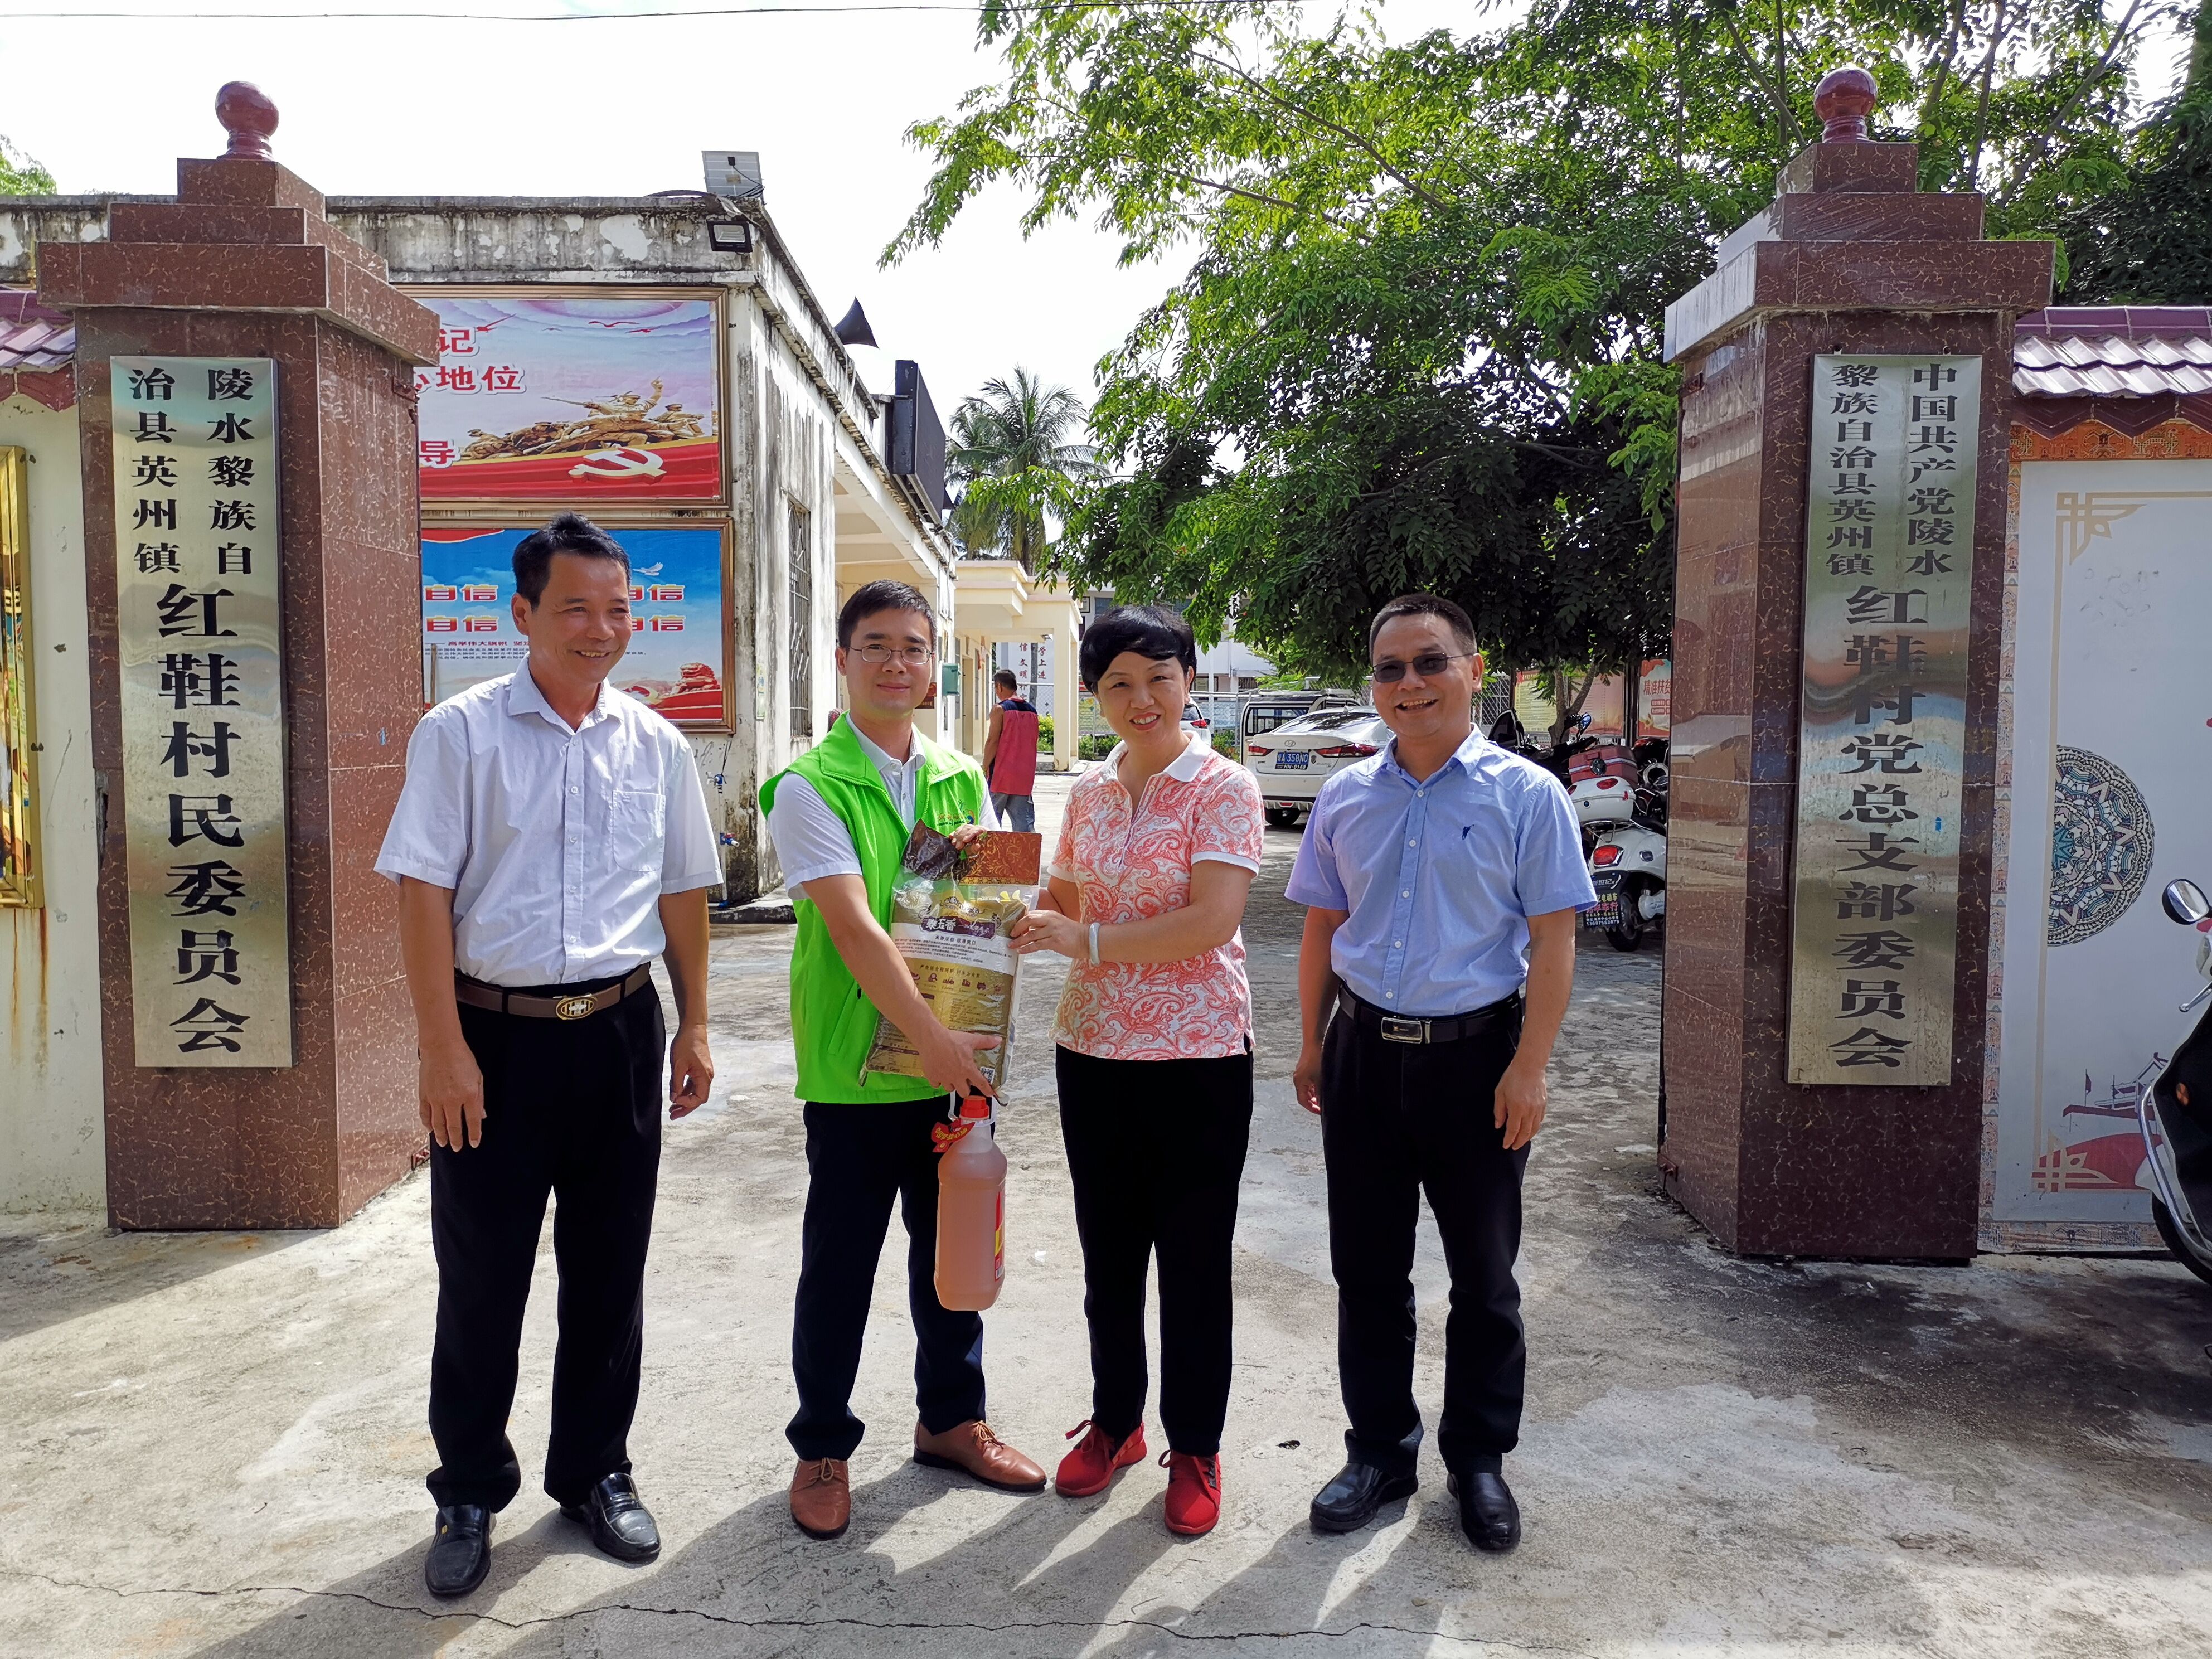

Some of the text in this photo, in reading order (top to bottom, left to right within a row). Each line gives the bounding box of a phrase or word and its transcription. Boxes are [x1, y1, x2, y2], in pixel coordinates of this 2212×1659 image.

[439, 328, 474, 353] 记
[128, 367, 181, 574] 治县英州镇
[207, 368, 256, 575] 陵水黎族自
[419, 440, 455, 464] 导
[1825, 364, 1880, 576] 黎族自治县英州镇
[1905, 363, 1958, 576] 中国共产党陵水
[425, 585, 498, 601] 自信
[426, 616, 499, 632] 自信
[156, 583, 251, 1053] 红鞋村民委员会
[1830, 585, 1927, 1068] 红鞋村党总支部委员会
